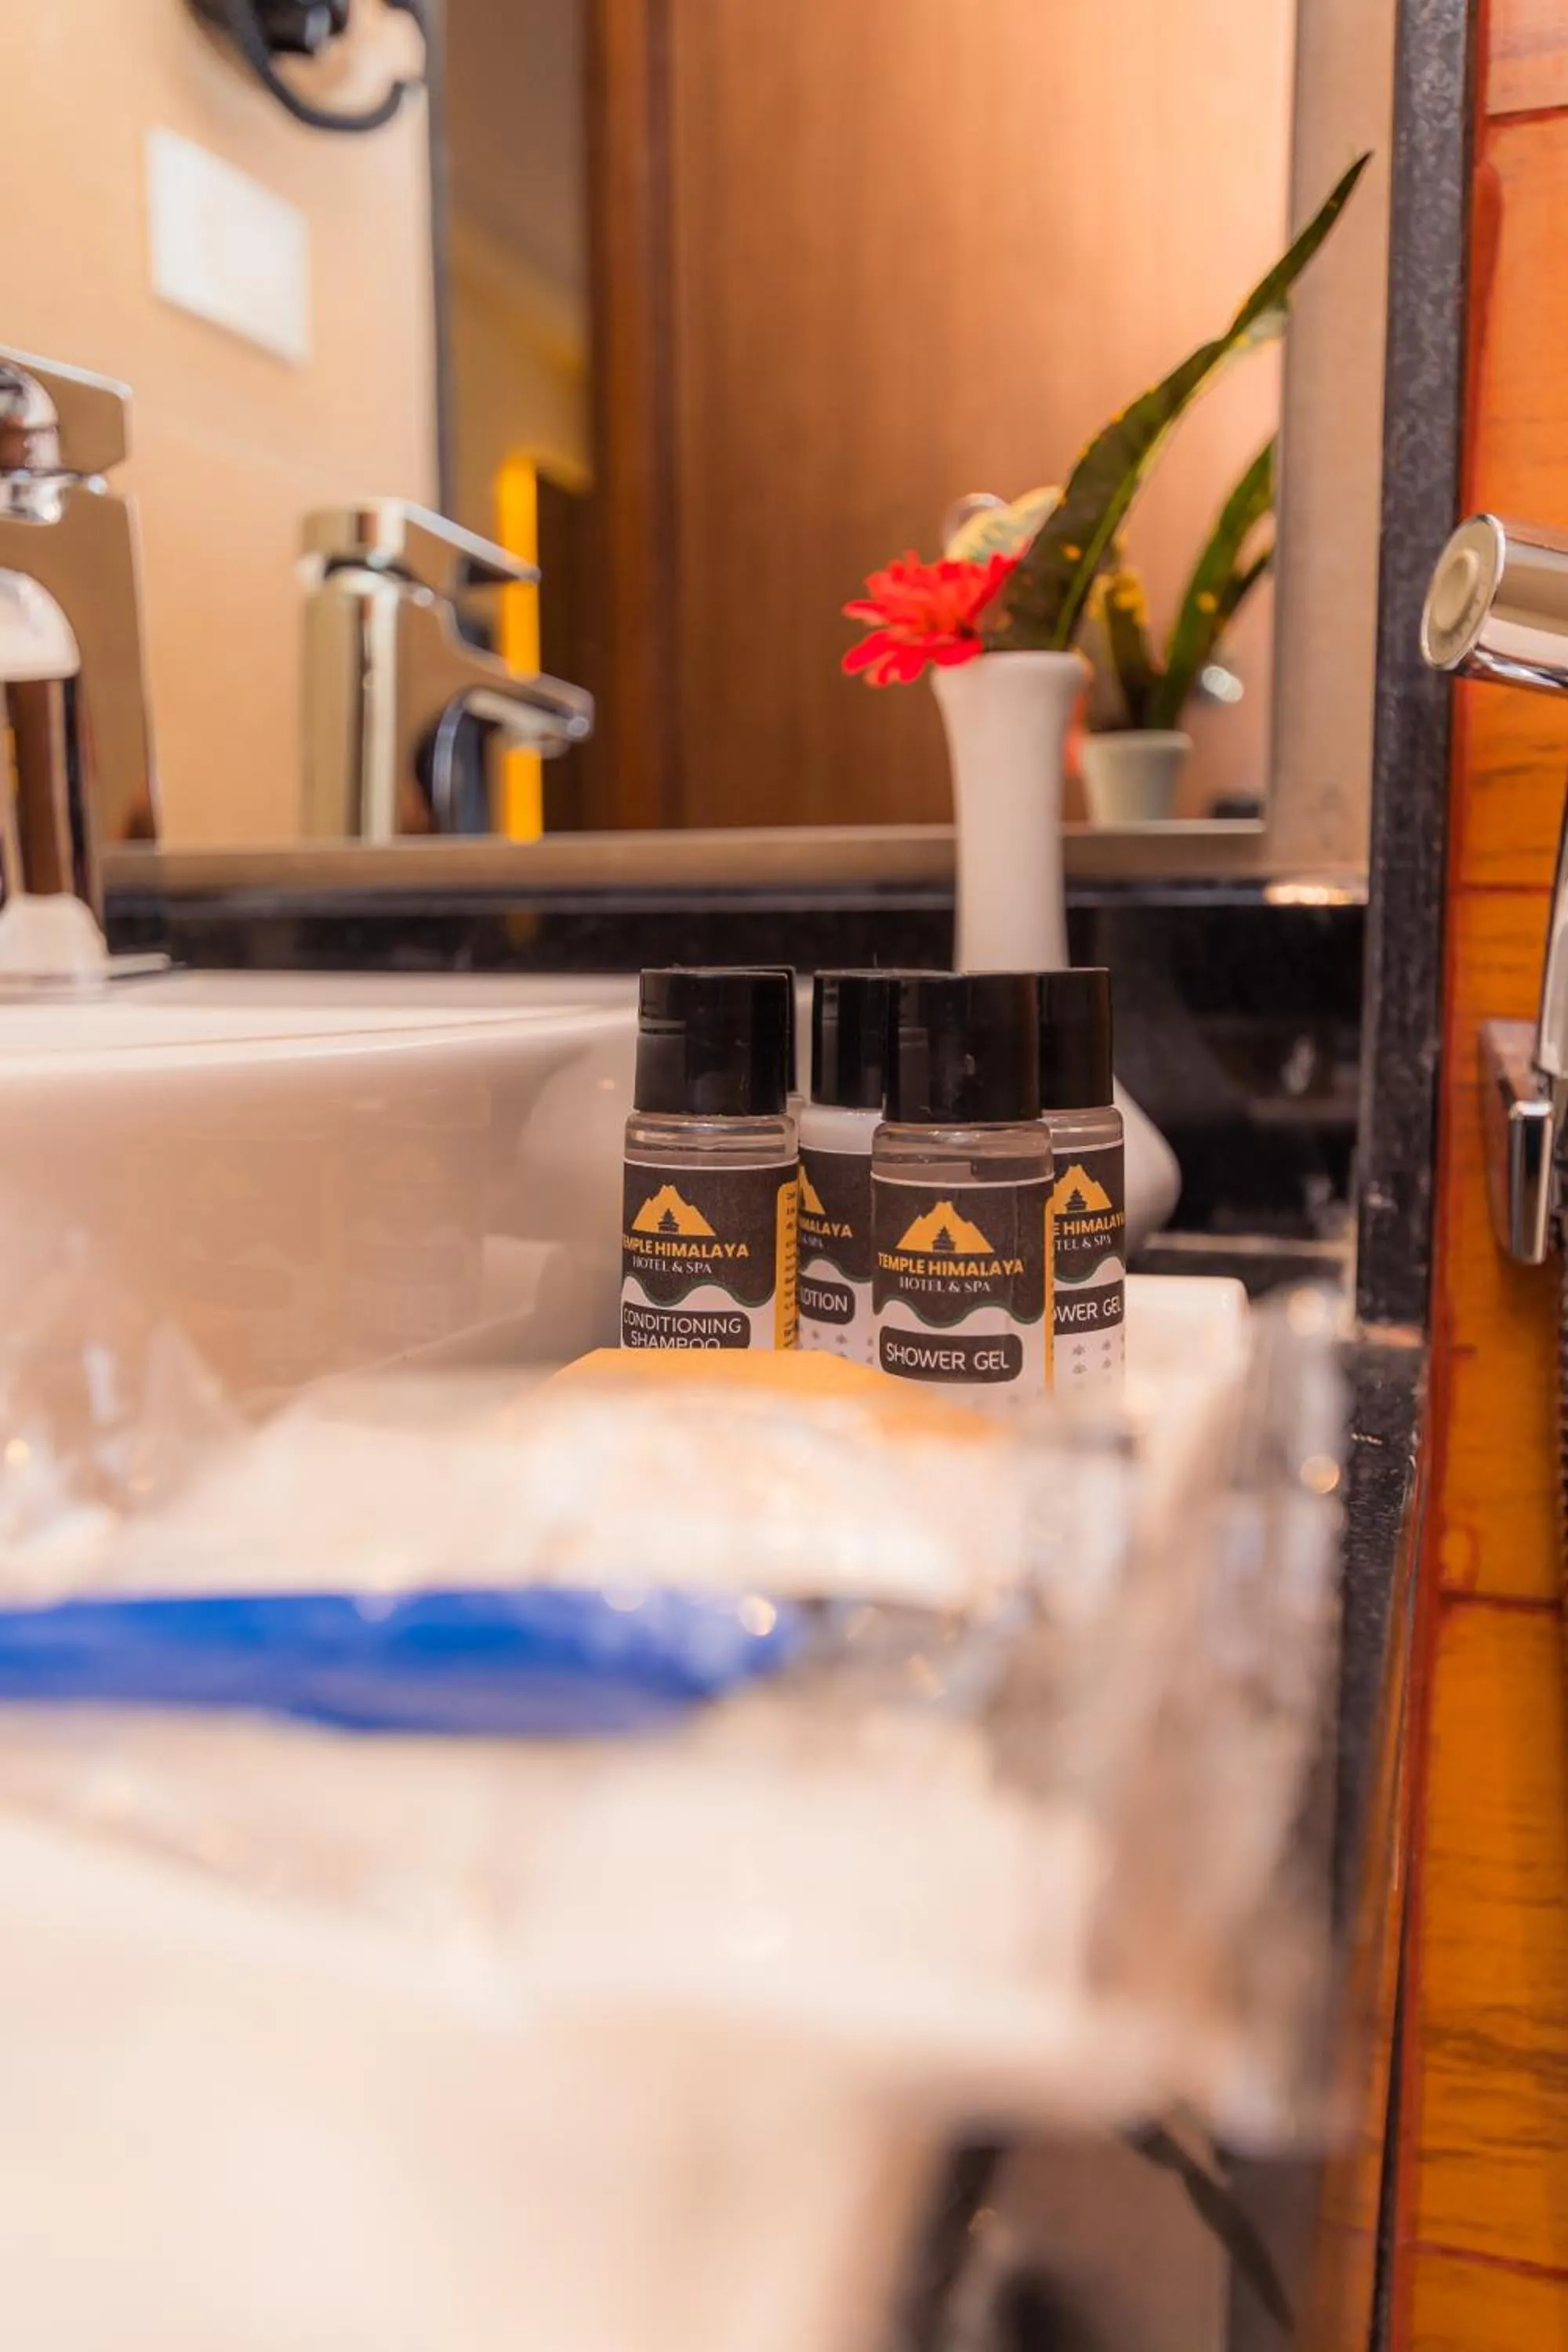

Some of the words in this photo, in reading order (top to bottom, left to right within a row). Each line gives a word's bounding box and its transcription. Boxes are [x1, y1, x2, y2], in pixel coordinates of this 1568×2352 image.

[622, 1236, 652, 1254] EMPLE
[655, 1241, 750, 1258] HIMALAYA
[1054, 1238, 1080, 1251] TEL
[633, 1255, 670, 1272] HOTEL
[672, 1260, 682, 1272] &
[686, 1261, 712, 1274] SPA
[878, 1253, 924, 1274] TEMPLE
[928, 1259, 1024, 1276] HIMALAYA
[899, 1276, 945, 1292] HOTEL
[948, 1280, 960, 1293] &
[964, 1280, 991, 1293] SPA
[1102, 1296, 1121, 1316] GEL
[623, 1308, 742, 1334] CONDITIONING
[886, 1342, 966, 1370] SHOWER
[973, 1350, 1010, 1370] GEL
